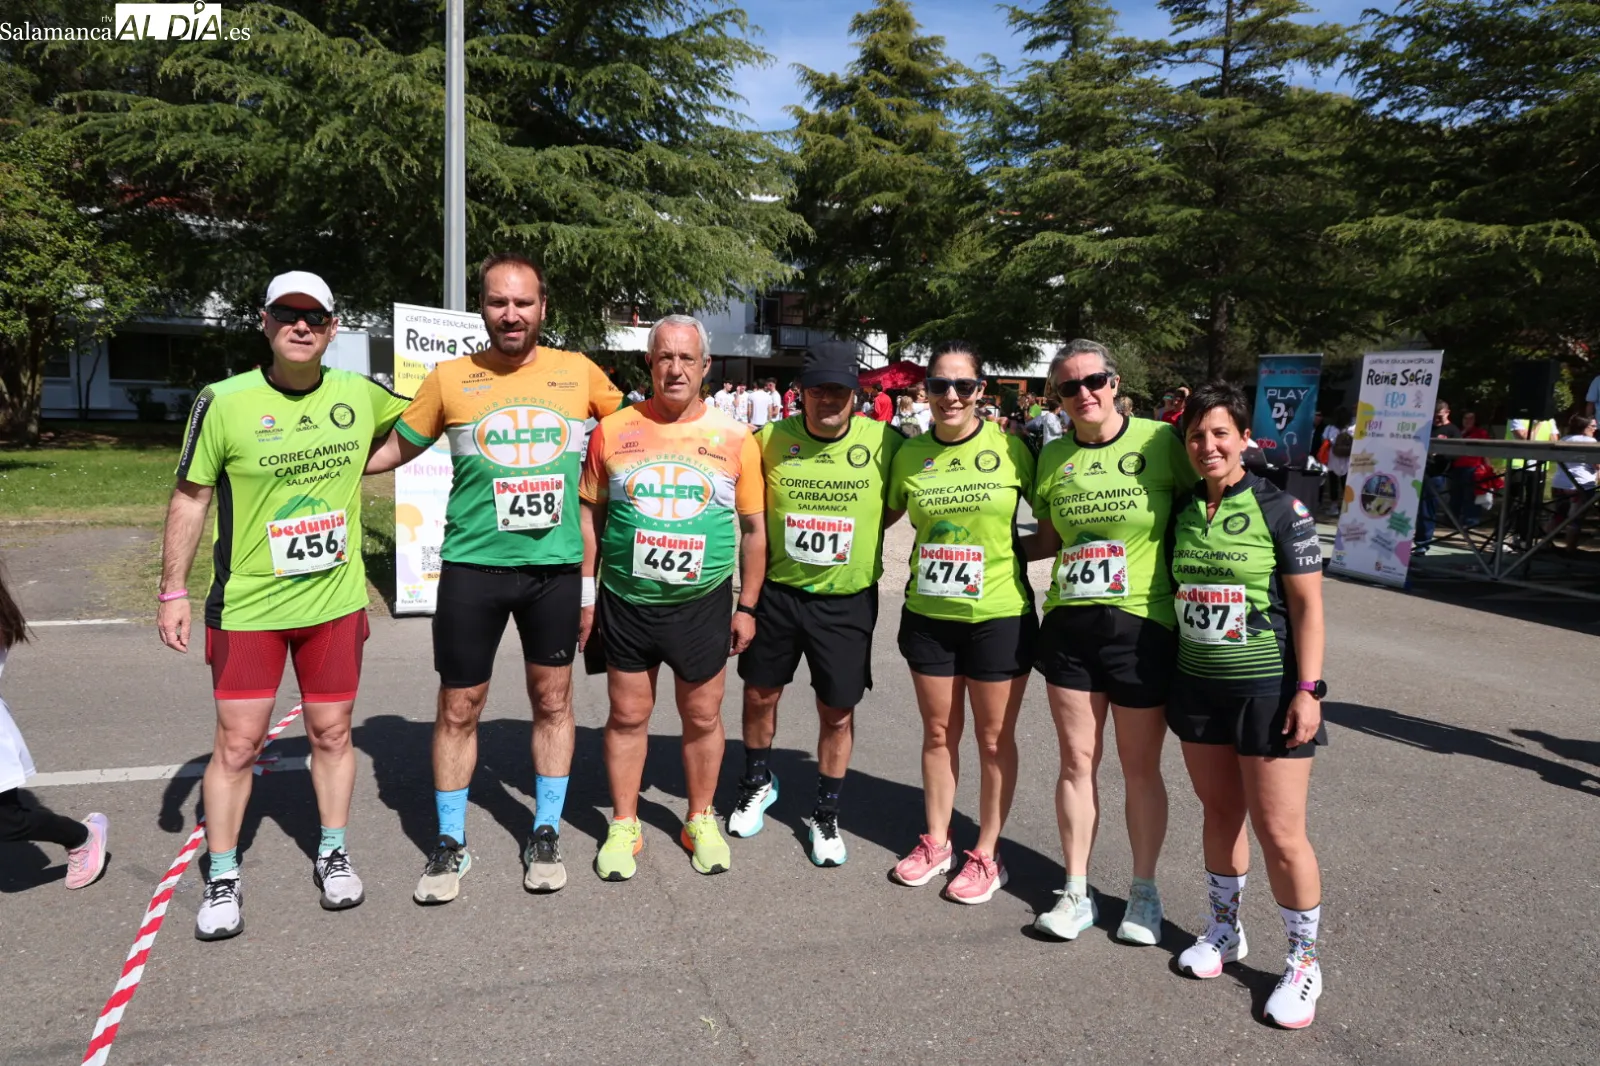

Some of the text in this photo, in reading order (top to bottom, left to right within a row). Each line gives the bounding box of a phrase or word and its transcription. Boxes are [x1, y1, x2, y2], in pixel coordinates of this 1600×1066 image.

[406, 328, 457, 356] Reina
[1366, 368, 1432, 386] Reina Sofía
[1266, 388, 1309, 400] PLAY
[472, 397, 570, 421] CLUB DEPORTIVO
[484, 427, 562, 446] ALCER
[259, 440, 360, 468] CORRECAMINOS
[274, 456, 352, 478] CARBAJOSA
[624, 456, 652, 474] CLUB
[656, 454, 714, 478] DEPORTIVO
[286, 471, 341, 487] SALAMANCA
[495, 478, 563, 495] bedunia
[780, 477, 870, 491] CORRECAMINOS
[632, 482, 705, 503] ALCER
[788, 490, 858, 503] CARBAJOSA
[912, 482, 1002, 499] CORRECAMINOS
[918, 492, 992, 508] CARBAJOSA
[1052, 486, 1150, 508] CORRECAMINOS
[509, 492, 556, 518] 458
[797, 503, 848, 512] SALAMANCA
[929, 506, 980, 517] SALAMANCA
[1059, 500, 1138, 518] CARBAJOSA
[270, 514, 345, 539] bedunia
[786, 514, 852, 533] bedunia
[1069, 514, 1126, 527] SALAMANCA
[286, 530, 339, 561] 456
[636, 531, 704, 551] bedunia
[795, 530, 840, 554] 401
[644, 548, 693, 573] 462
[920, 546, 982, 564] bedunia
[925, 561, 971, 586] 474
[1066, 560, 1110, 584] 461
[1174, 564, 1235, 578] CARBAJOSA
[1184, 603, 1231, 631] 437
